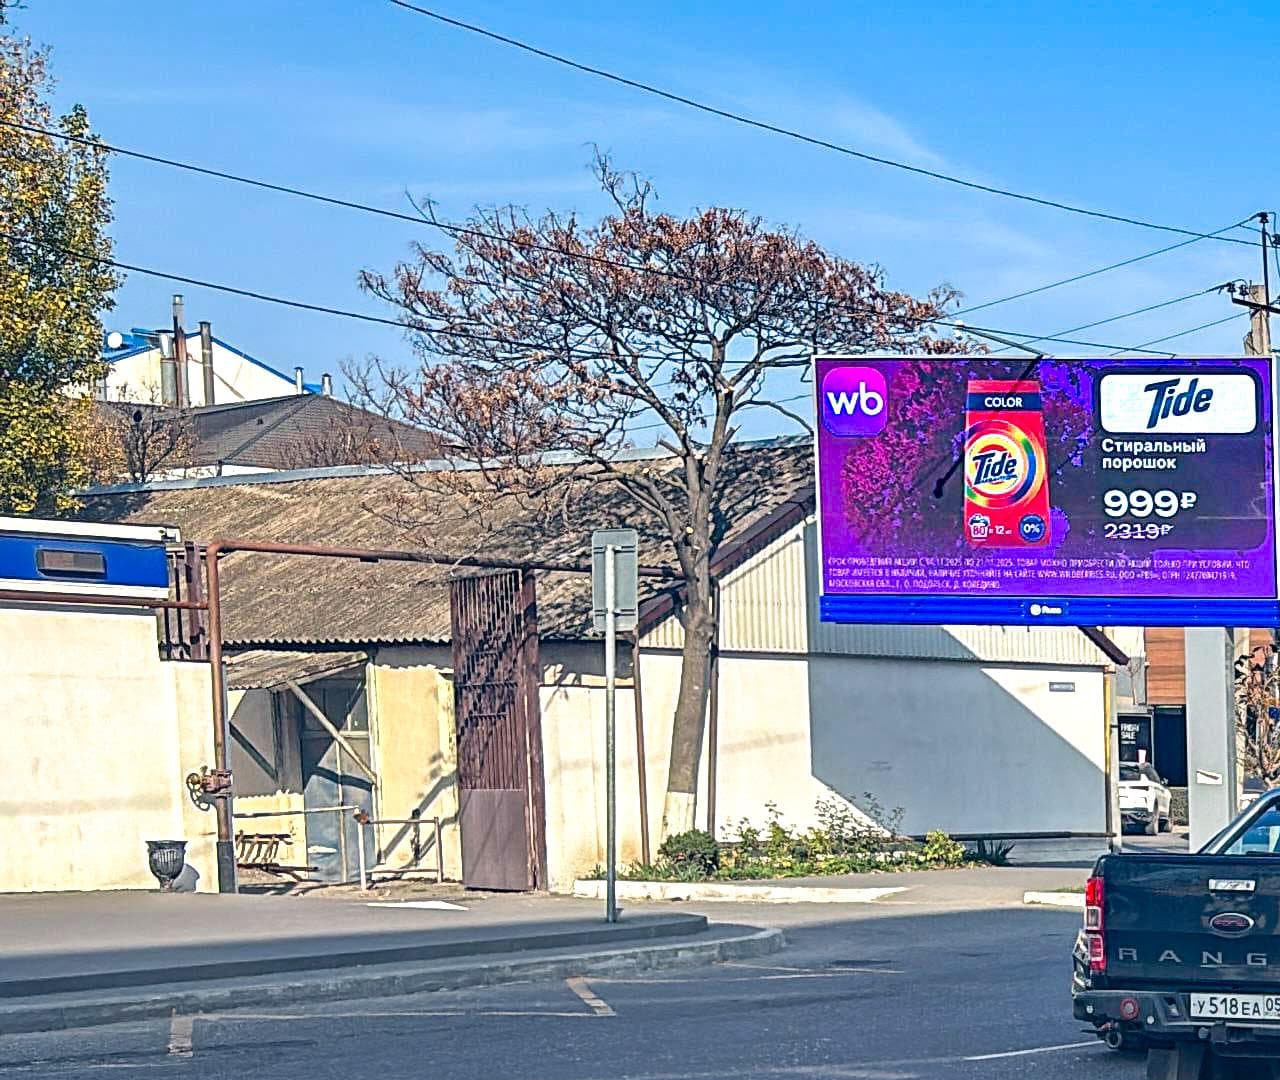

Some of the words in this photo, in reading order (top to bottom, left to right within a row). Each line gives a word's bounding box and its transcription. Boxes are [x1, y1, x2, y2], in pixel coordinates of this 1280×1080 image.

[827, 382, 884, 416] wb
[984, 397, 1023, 408] COLOR
[1144, 378, 1214, 429] Tide
[1102, 438, 1206, 457] Стиральный
[972, 451, 1018, 486] Tide
[1103, 457, 1177, 473] порошок
[1023, 523, 1041, 534] 0%
